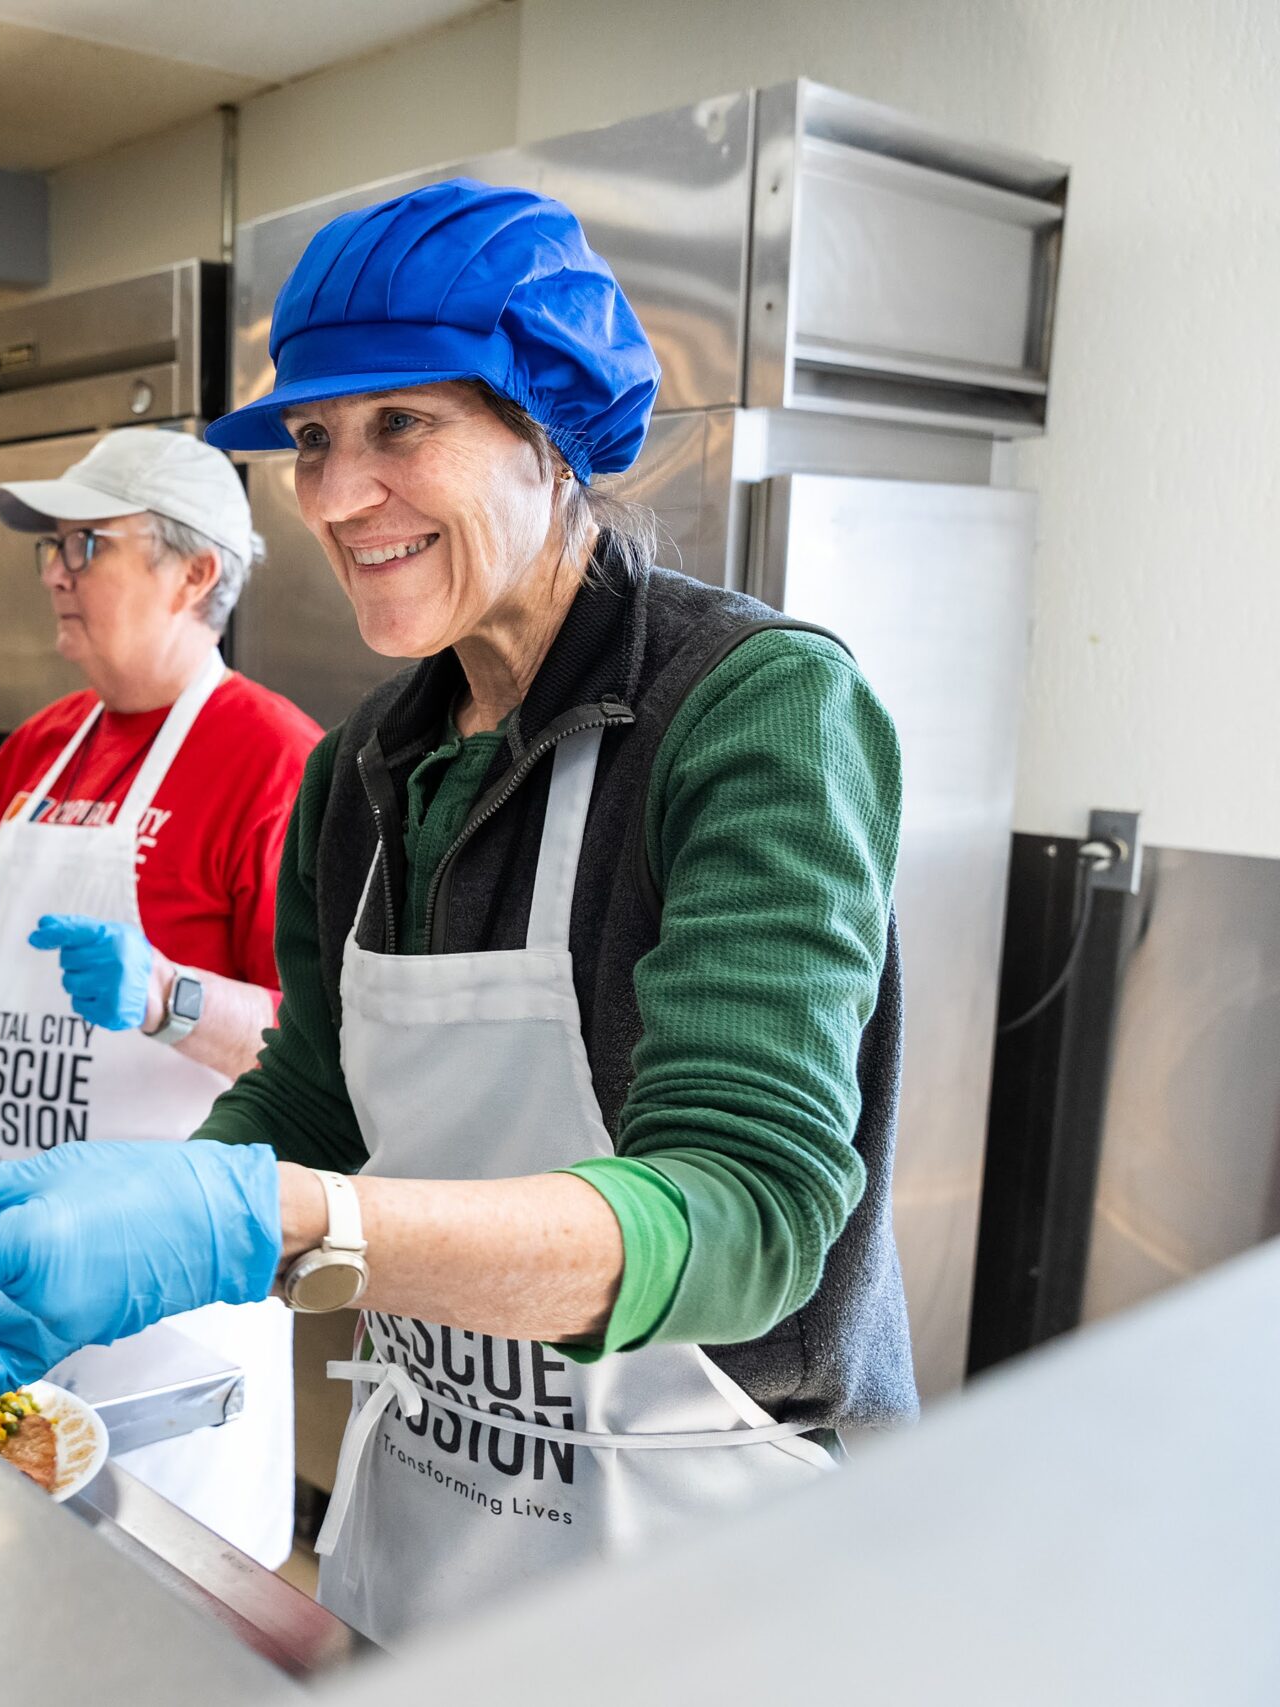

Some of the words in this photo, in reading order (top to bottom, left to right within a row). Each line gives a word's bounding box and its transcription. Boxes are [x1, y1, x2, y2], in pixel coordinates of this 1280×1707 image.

[40, 1013, 95, 1049] CITY
[369, 1344, 575, 1485] SSION
[383, 1433, 503, 1515] Transforming
[512, 1497, 573, 1525] Lives
